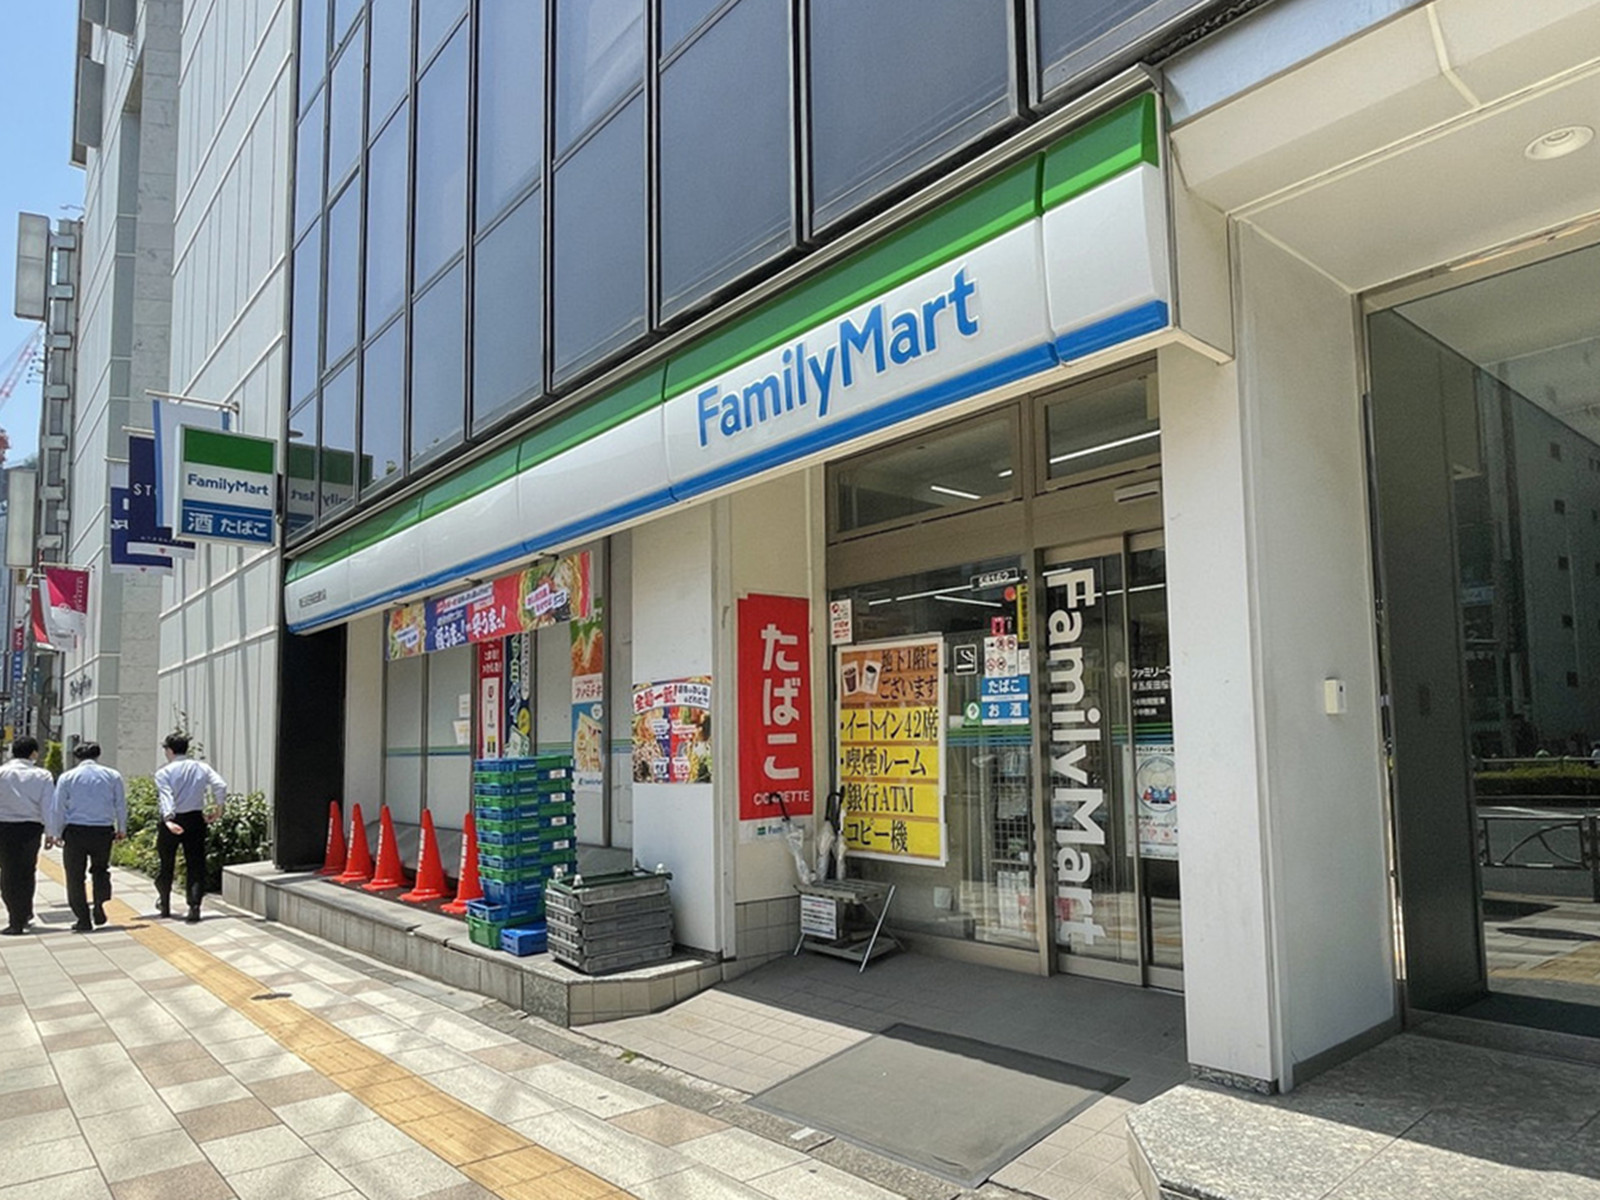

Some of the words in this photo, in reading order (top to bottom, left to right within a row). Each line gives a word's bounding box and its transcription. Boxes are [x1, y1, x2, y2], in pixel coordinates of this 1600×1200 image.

[697, 266, 978, 447] FamilyMart
[187, 473, 270, 496] FamilyMart
[188, 511, 213, 533] 酒
[220, 517, 268, 537] たばこ
[988, 679, 1021, 694] たばこ
[760, 623, 800, 780] たばこ
[988, 702, 1022, 718] お酒
[1047, 568, 1107, 946] FamilyMart
